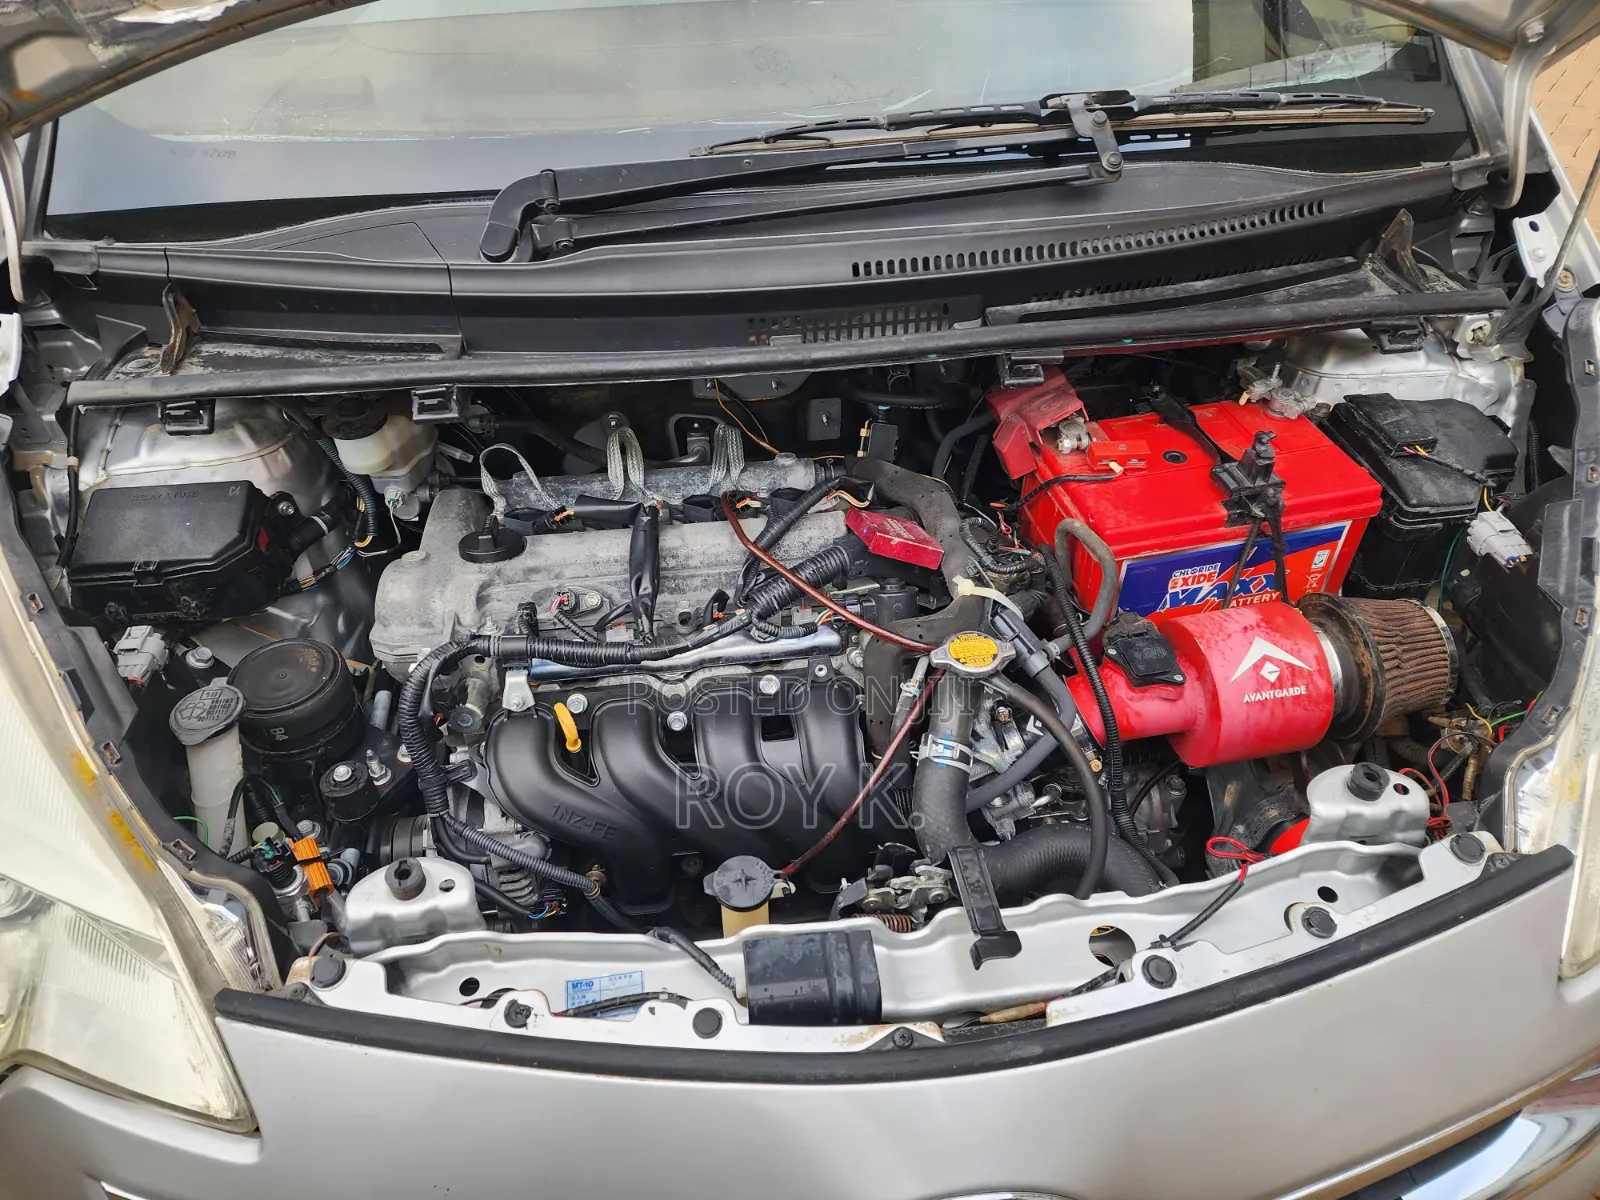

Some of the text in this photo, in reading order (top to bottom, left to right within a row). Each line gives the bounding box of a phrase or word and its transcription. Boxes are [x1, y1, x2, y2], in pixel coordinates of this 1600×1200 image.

[174, 491, 199, 500] FUSE
[1172, 563, 1221, 578] CHLORIDE
[1169, 570, 1218, 591] EXIDE
[1228, 591, 1280, 609] ATTERY
[1243, 685, 1307, 704] AVANTGARDE
[552, 804, 619, 841] 1NZ-FE
[572, 980, 594, 989] MT-10
